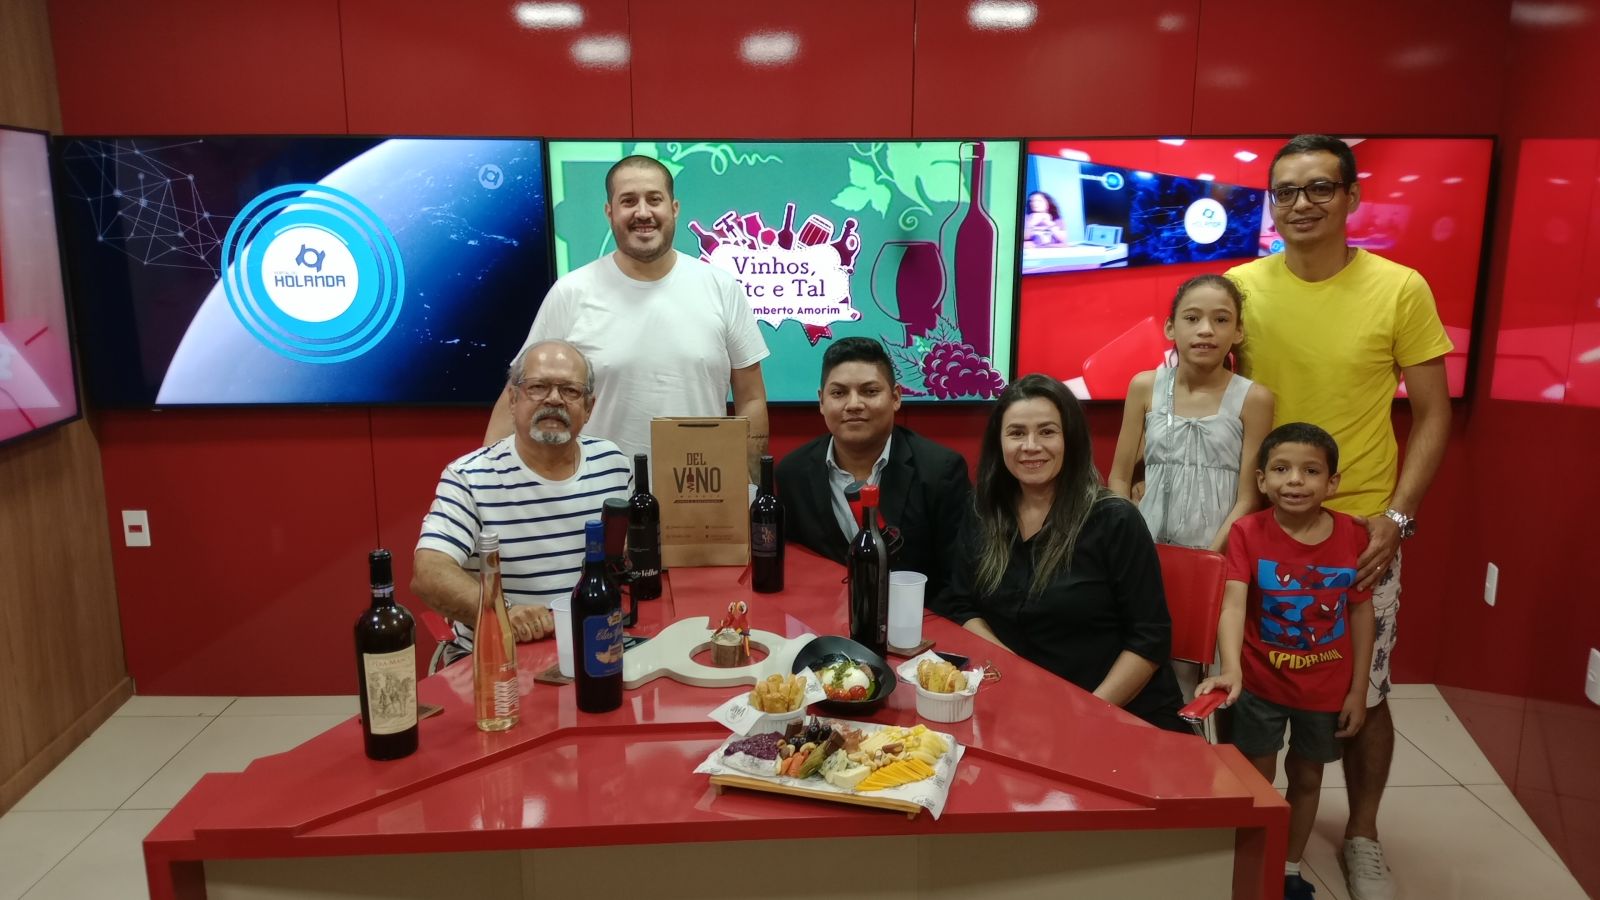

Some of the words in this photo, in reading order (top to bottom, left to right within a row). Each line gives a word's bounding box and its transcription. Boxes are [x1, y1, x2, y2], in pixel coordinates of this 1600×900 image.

[732, 256, 816, 276] Vinhos,
[274, 275, 346, 288] HOLANDA
[736, 279, 765, 297] tc
[773, 284, 784, 297] e
[792, 279, 826, 297] Tal
[752, 306, 794, 315] mberto
[797, 305, 840, 315] Amorim
[686, 452, 707, 466] DEL
[673, 466, 721, 495] VINO
[1269, 648, 1343, 670] SPIDER-MAN
